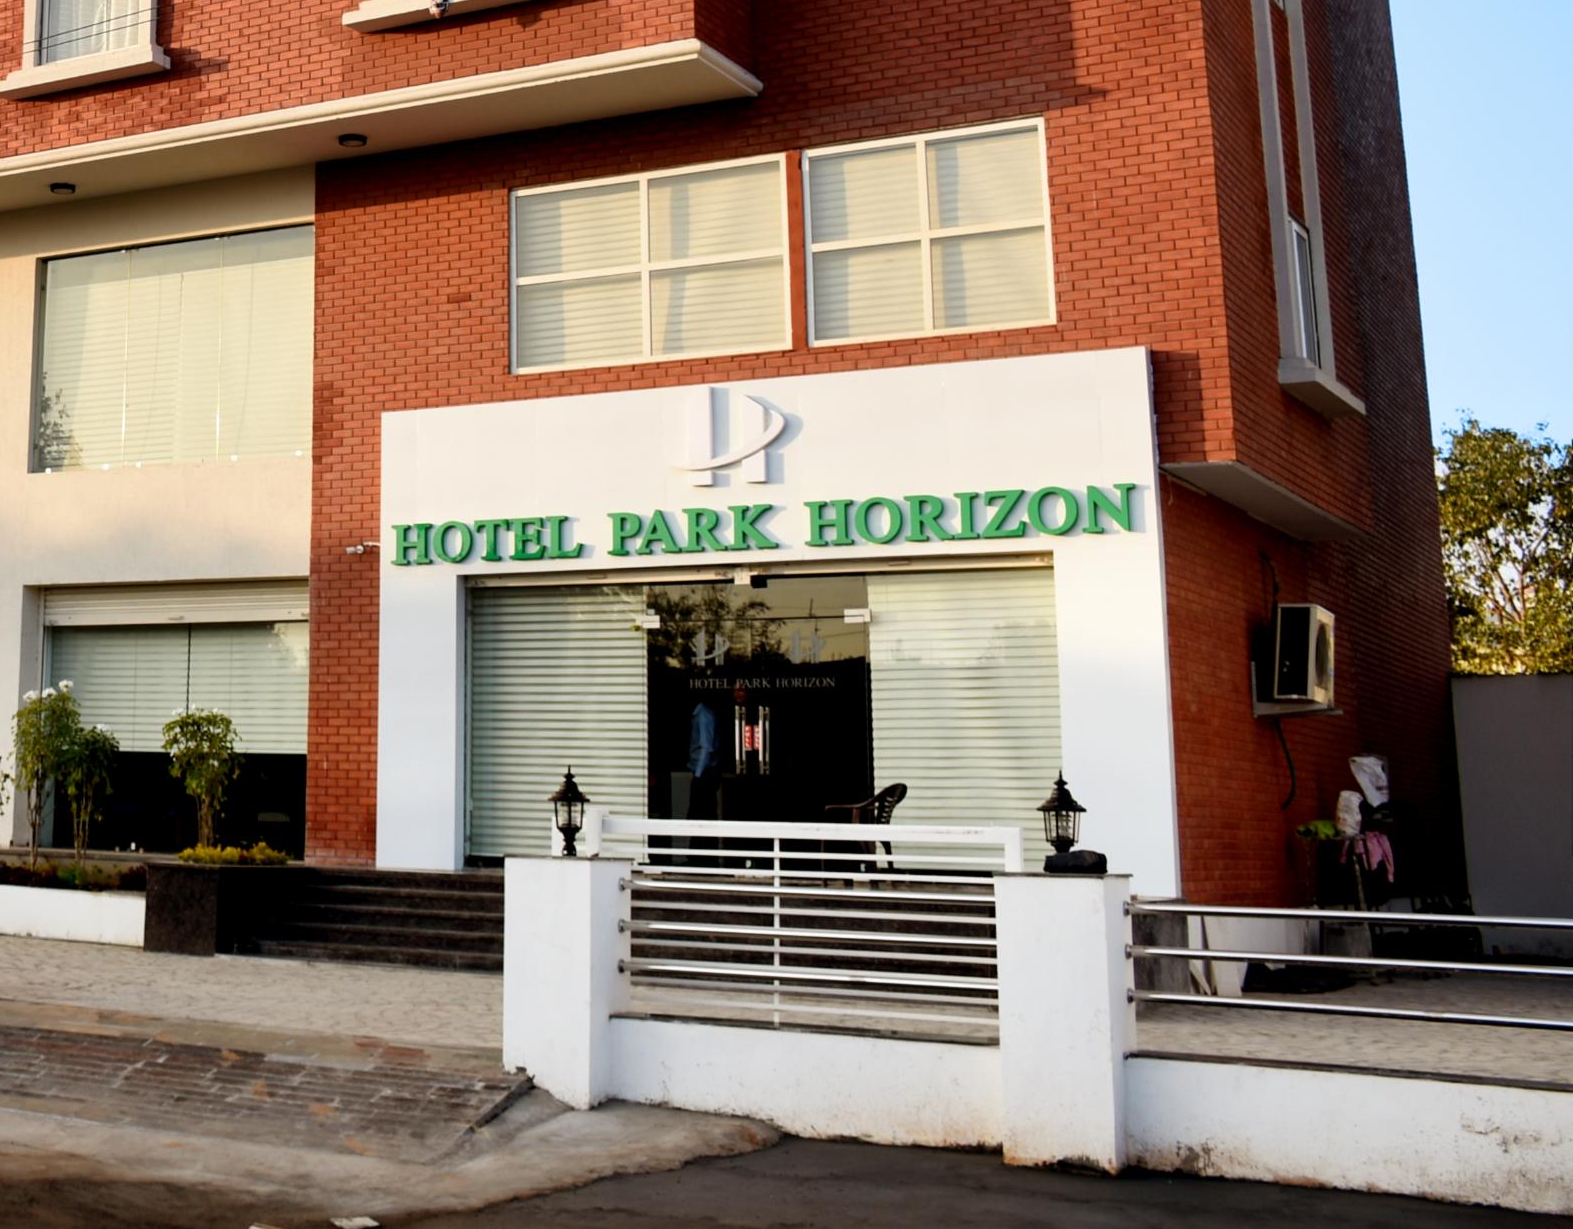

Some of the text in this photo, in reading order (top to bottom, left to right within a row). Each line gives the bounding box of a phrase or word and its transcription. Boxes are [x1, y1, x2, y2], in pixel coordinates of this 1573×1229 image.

[391, 483, 1137, 567] HOTEL PARK HORIZON
[688, 676, 836, 689] HOTEL PARK HORIZON
